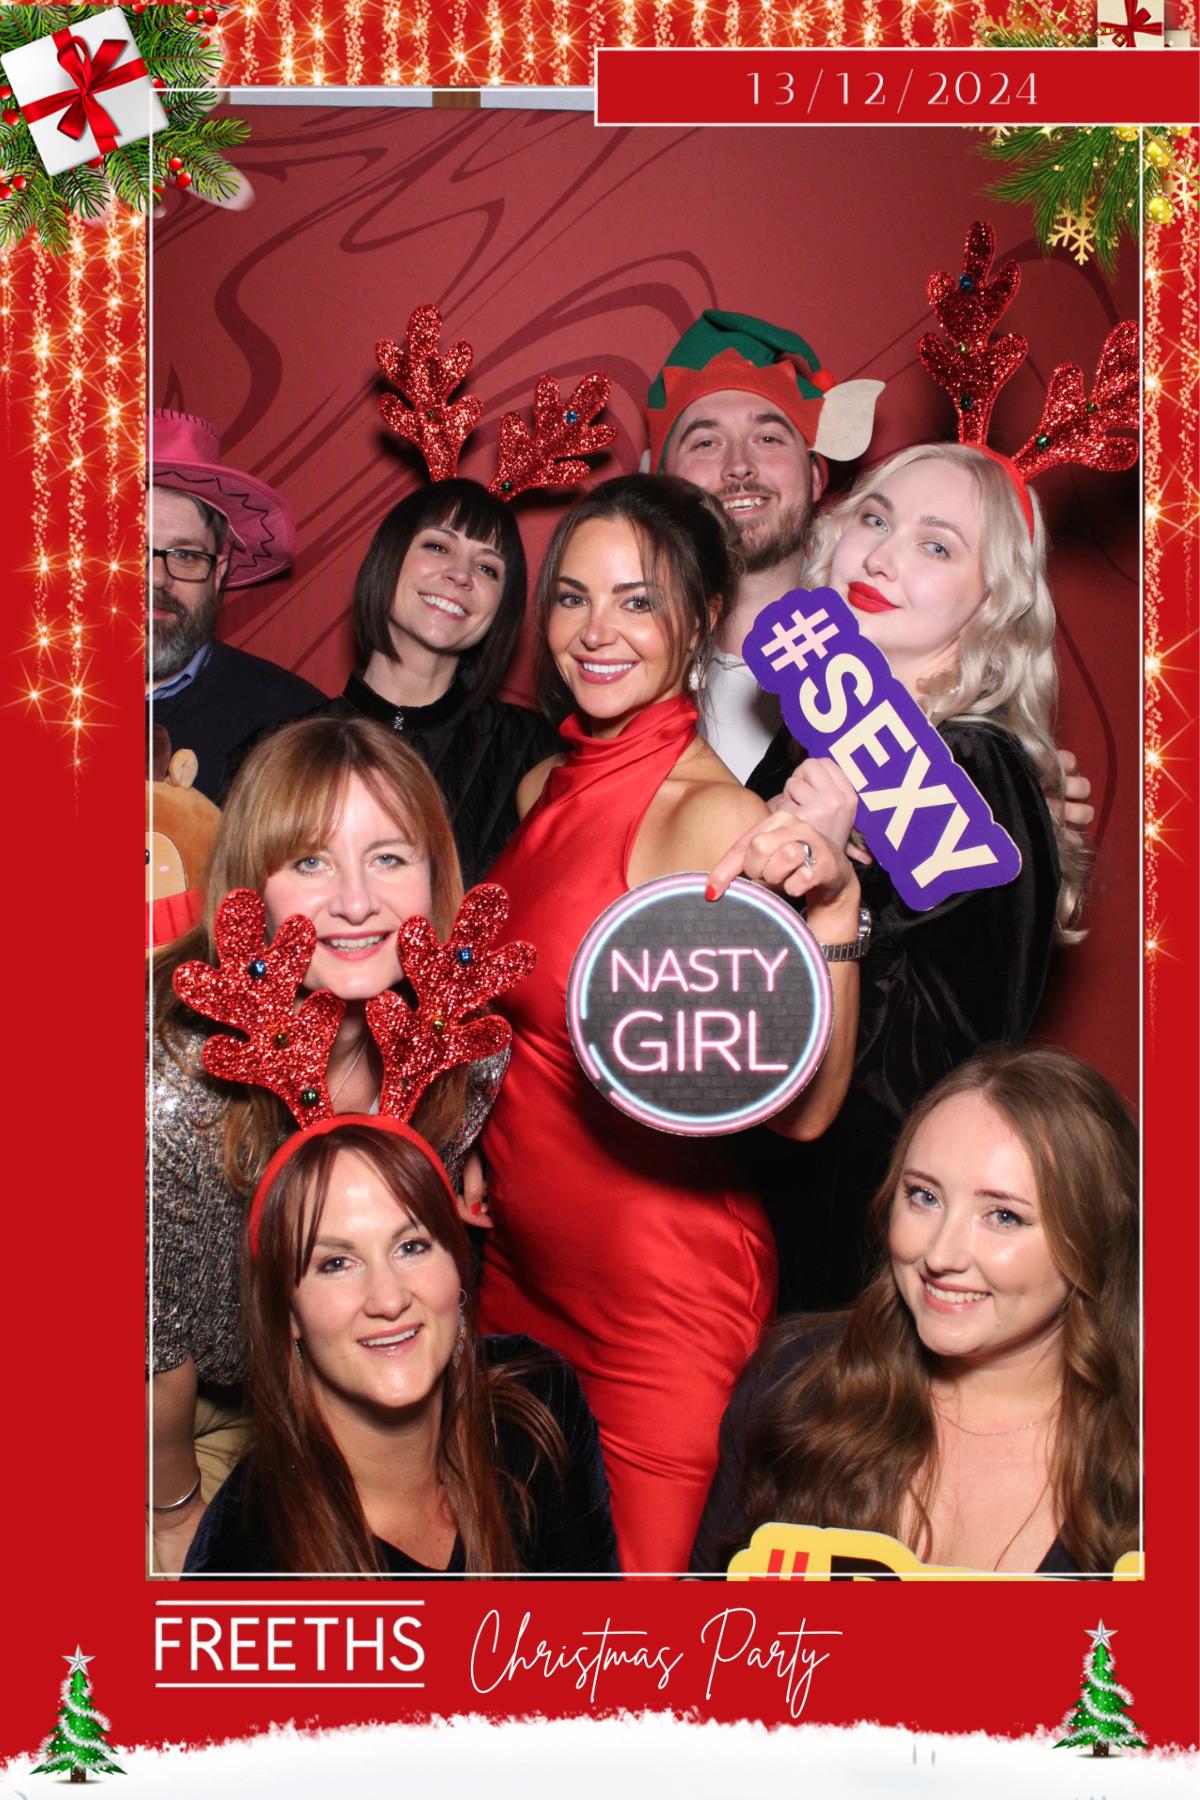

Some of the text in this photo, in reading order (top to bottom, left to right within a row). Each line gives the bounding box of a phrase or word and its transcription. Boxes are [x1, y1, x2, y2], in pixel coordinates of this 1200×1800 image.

[761, 607, 998, 889] #SEXY
[610, 947, 788, 993] NASTY
[612, 1009, 789, 1073] GIRL
